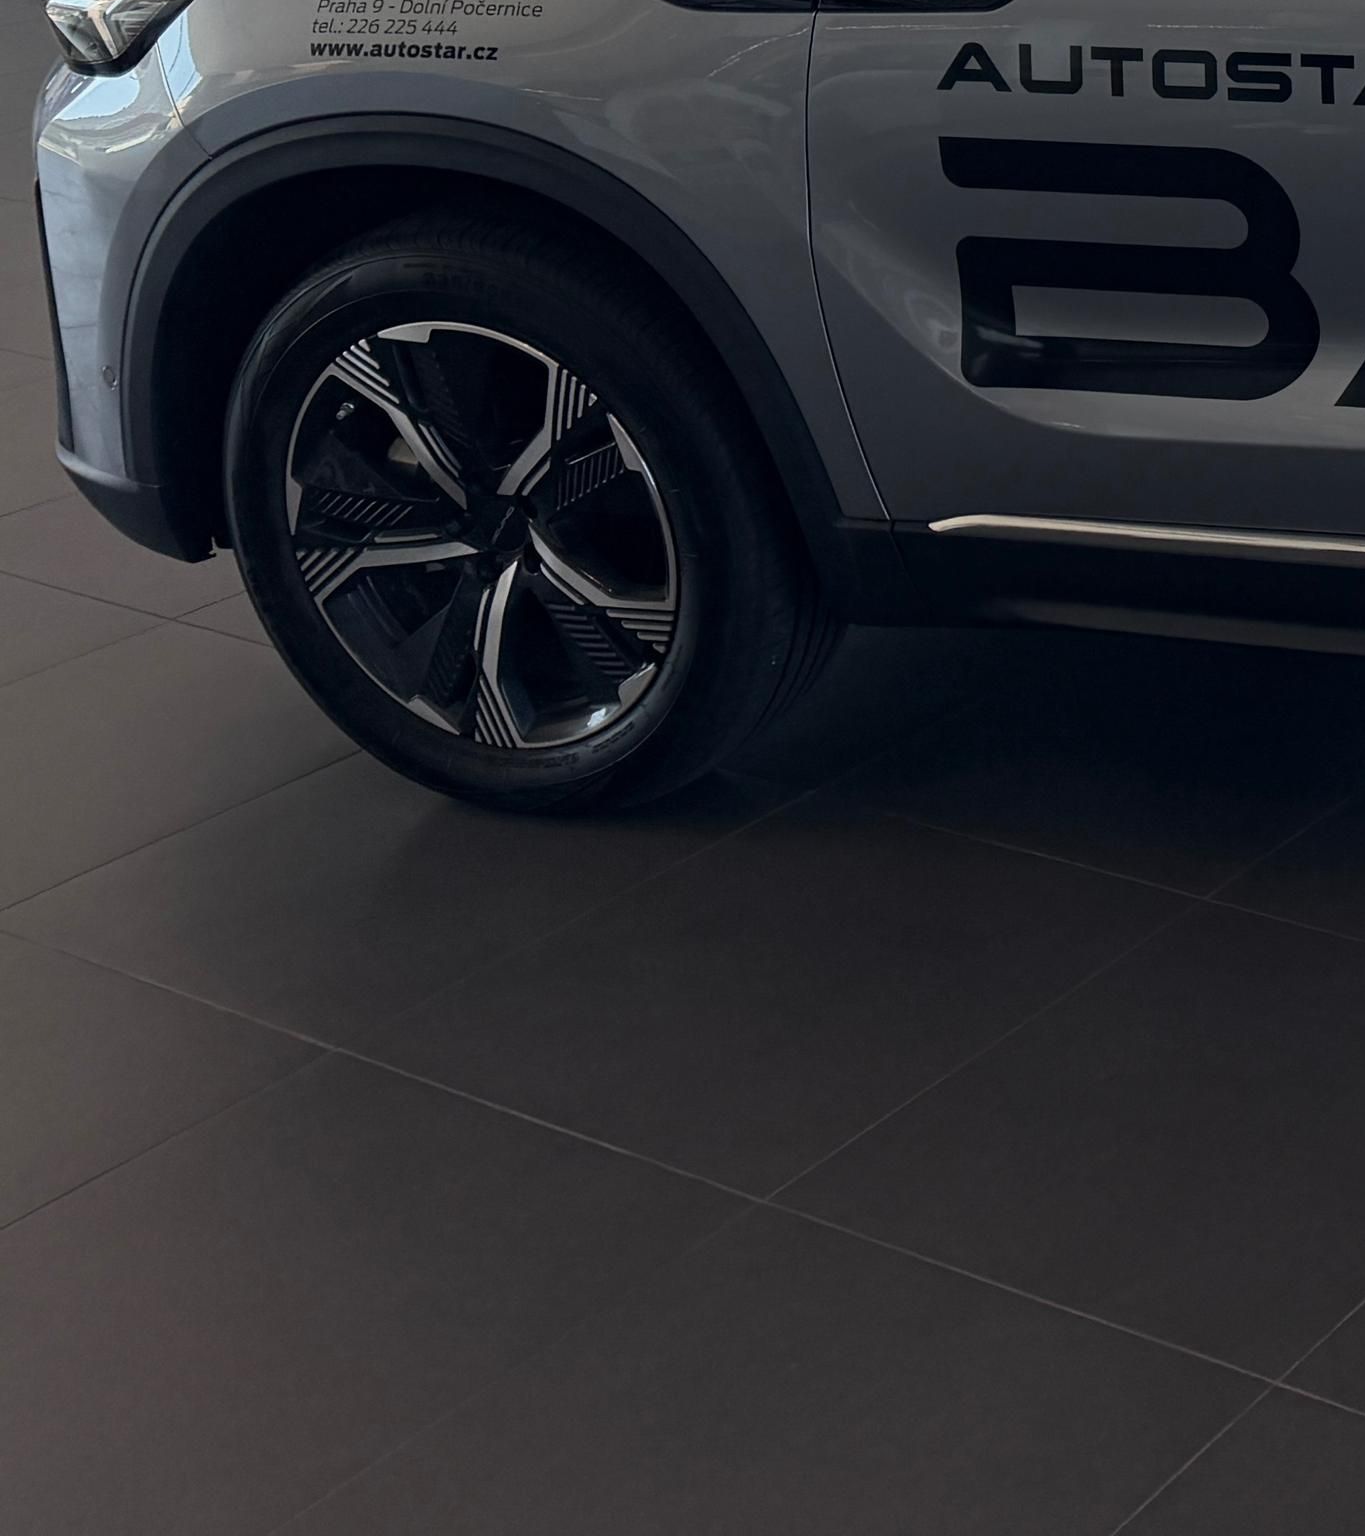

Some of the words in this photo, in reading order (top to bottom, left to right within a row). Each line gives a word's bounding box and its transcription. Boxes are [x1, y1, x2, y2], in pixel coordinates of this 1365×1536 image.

[317, 0, 366, 15] Praha
[372, 0, 384, 15] 9
[400, 0, 448, 16] Dolní
[450, 0, 544, 18] Počernice
[312, 19, 344, 35] tel.:
[346, 19, 380, 35] 226
[383, 20, 417, 35] 225
[422, 21, 458, 36] 444
[310, 40, 498, 61] www.autostar.cz
